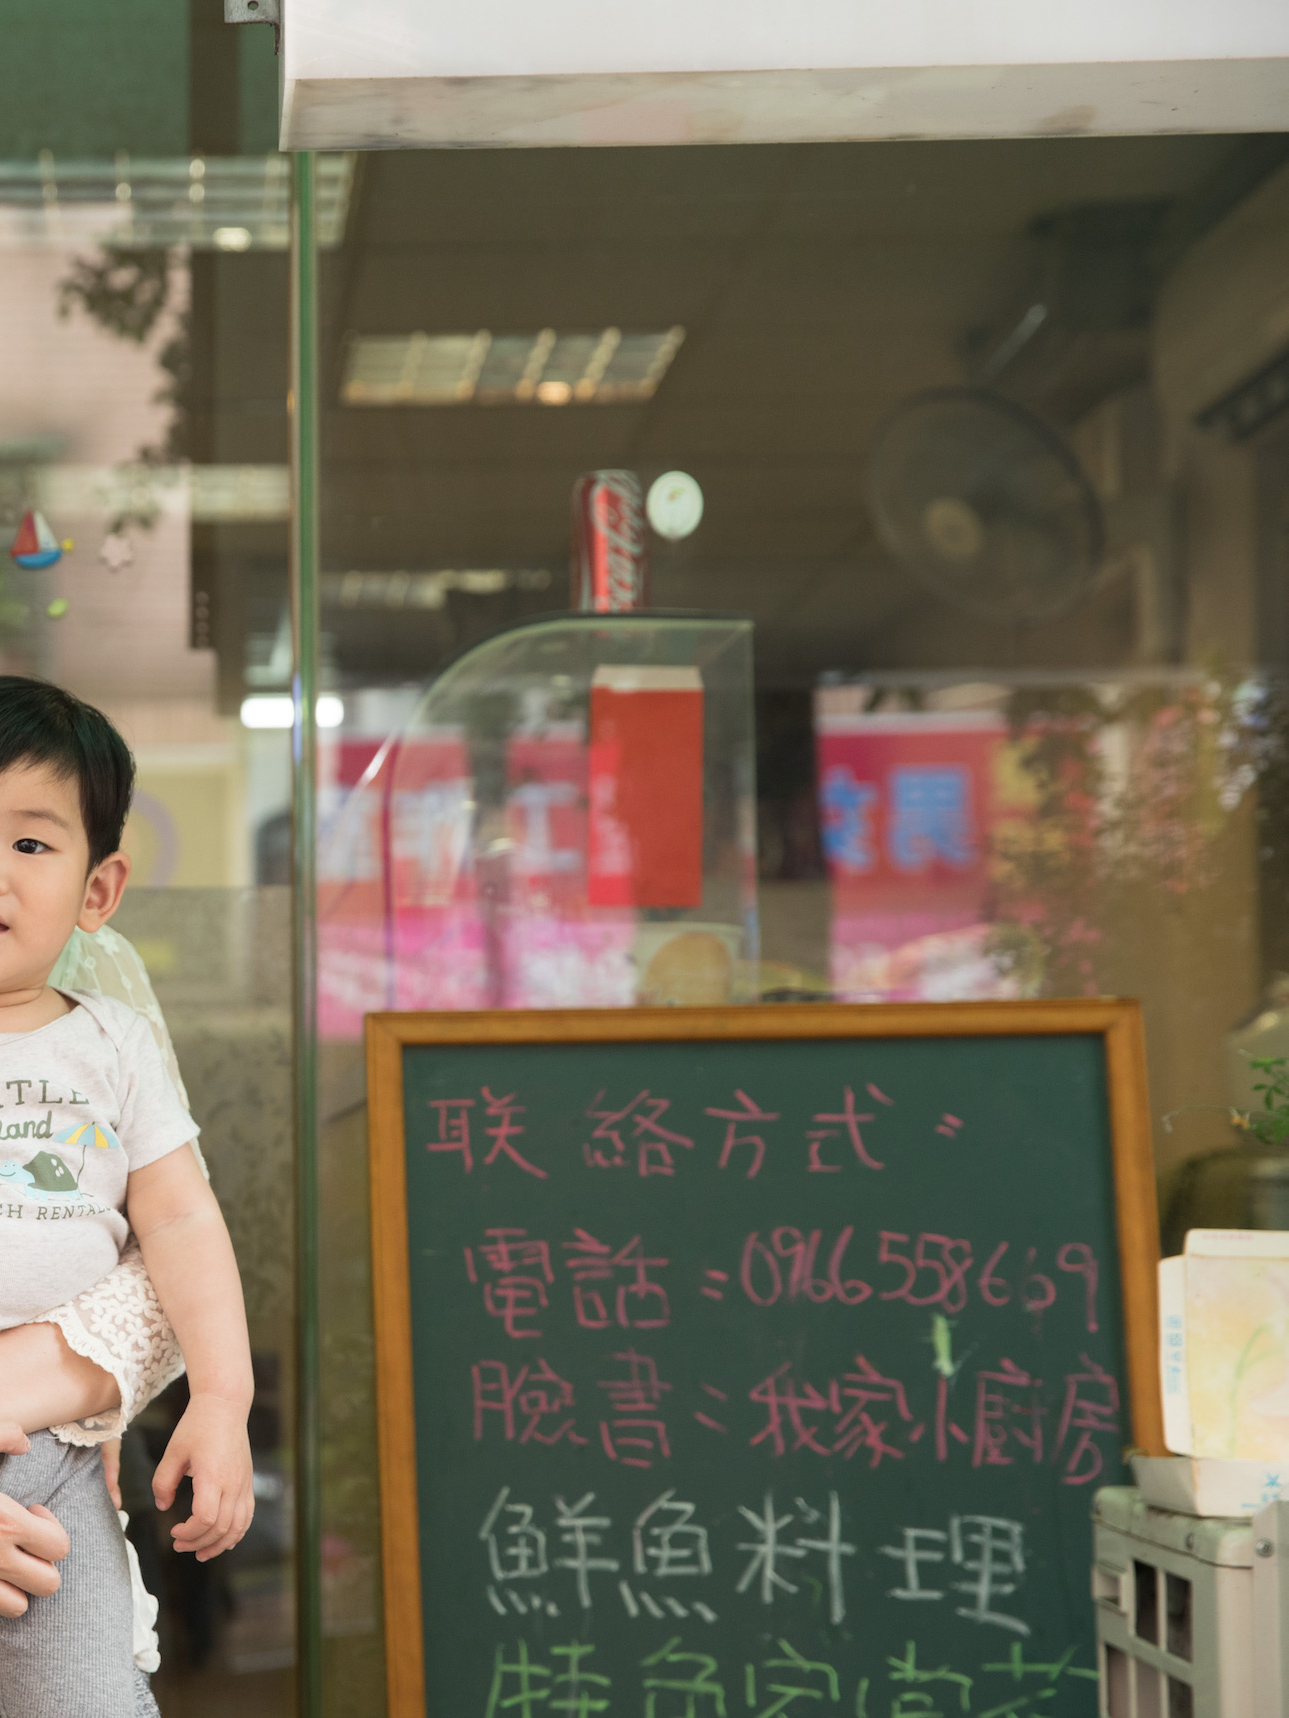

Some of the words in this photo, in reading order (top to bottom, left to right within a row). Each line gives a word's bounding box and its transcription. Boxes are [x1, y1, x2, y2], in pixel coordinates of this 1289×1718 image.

[36, 1202, 111, 1220] RENTAL
[479, 1487, 1031, 1634] 鮮魚料理
